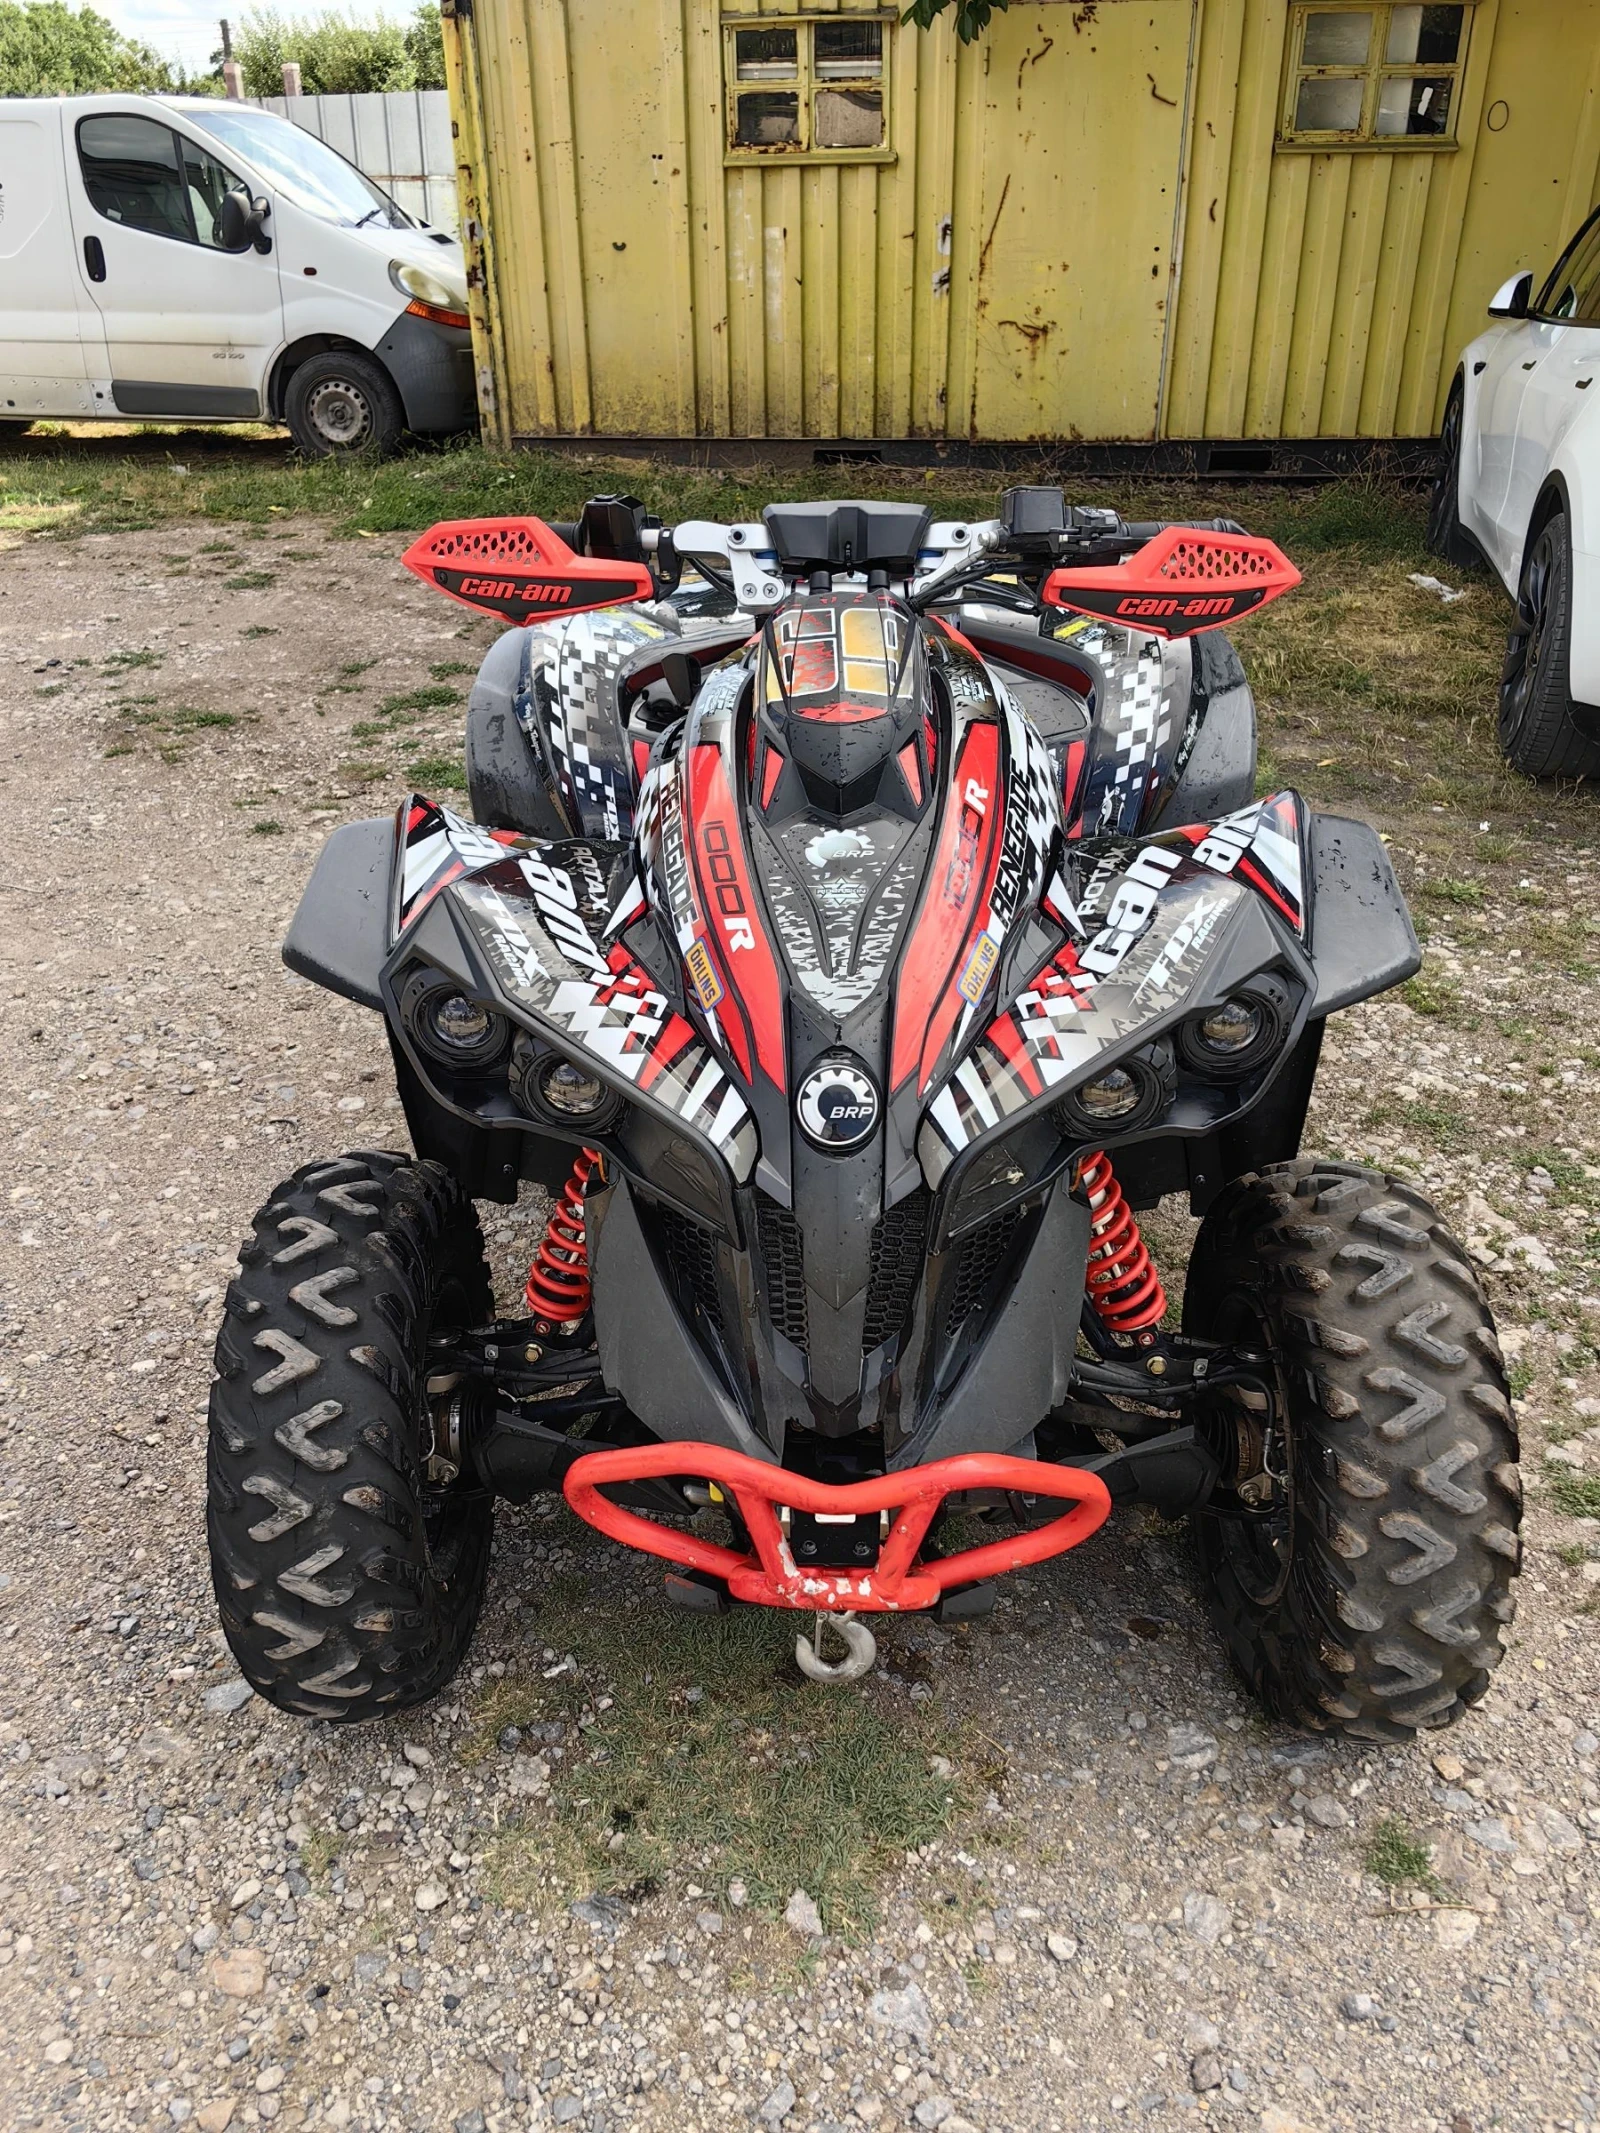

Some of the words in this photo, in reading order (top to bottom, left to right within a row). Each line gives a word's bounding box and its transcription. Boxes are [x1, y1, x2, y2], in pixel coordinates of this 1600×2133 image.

[459, 577, 572, 603] can-am
[1115, 596, 1235, 617] can-am
[660, 772, 700, 934] RENEGADE
[832, 849, 876, 858] BRP
[988, 754, 1031, 933] RENEGADE
[701, 820, 756, 953] 1000R
[1077, 845, 1134, 916] ROTAX
[1190, 898, 1229, 950] RACING
[690, 945, 716, 1003] ÖHLINS
[963, 942, 995, 997] ÖHLINS
[829, 1106, 873, 1119] BRP
